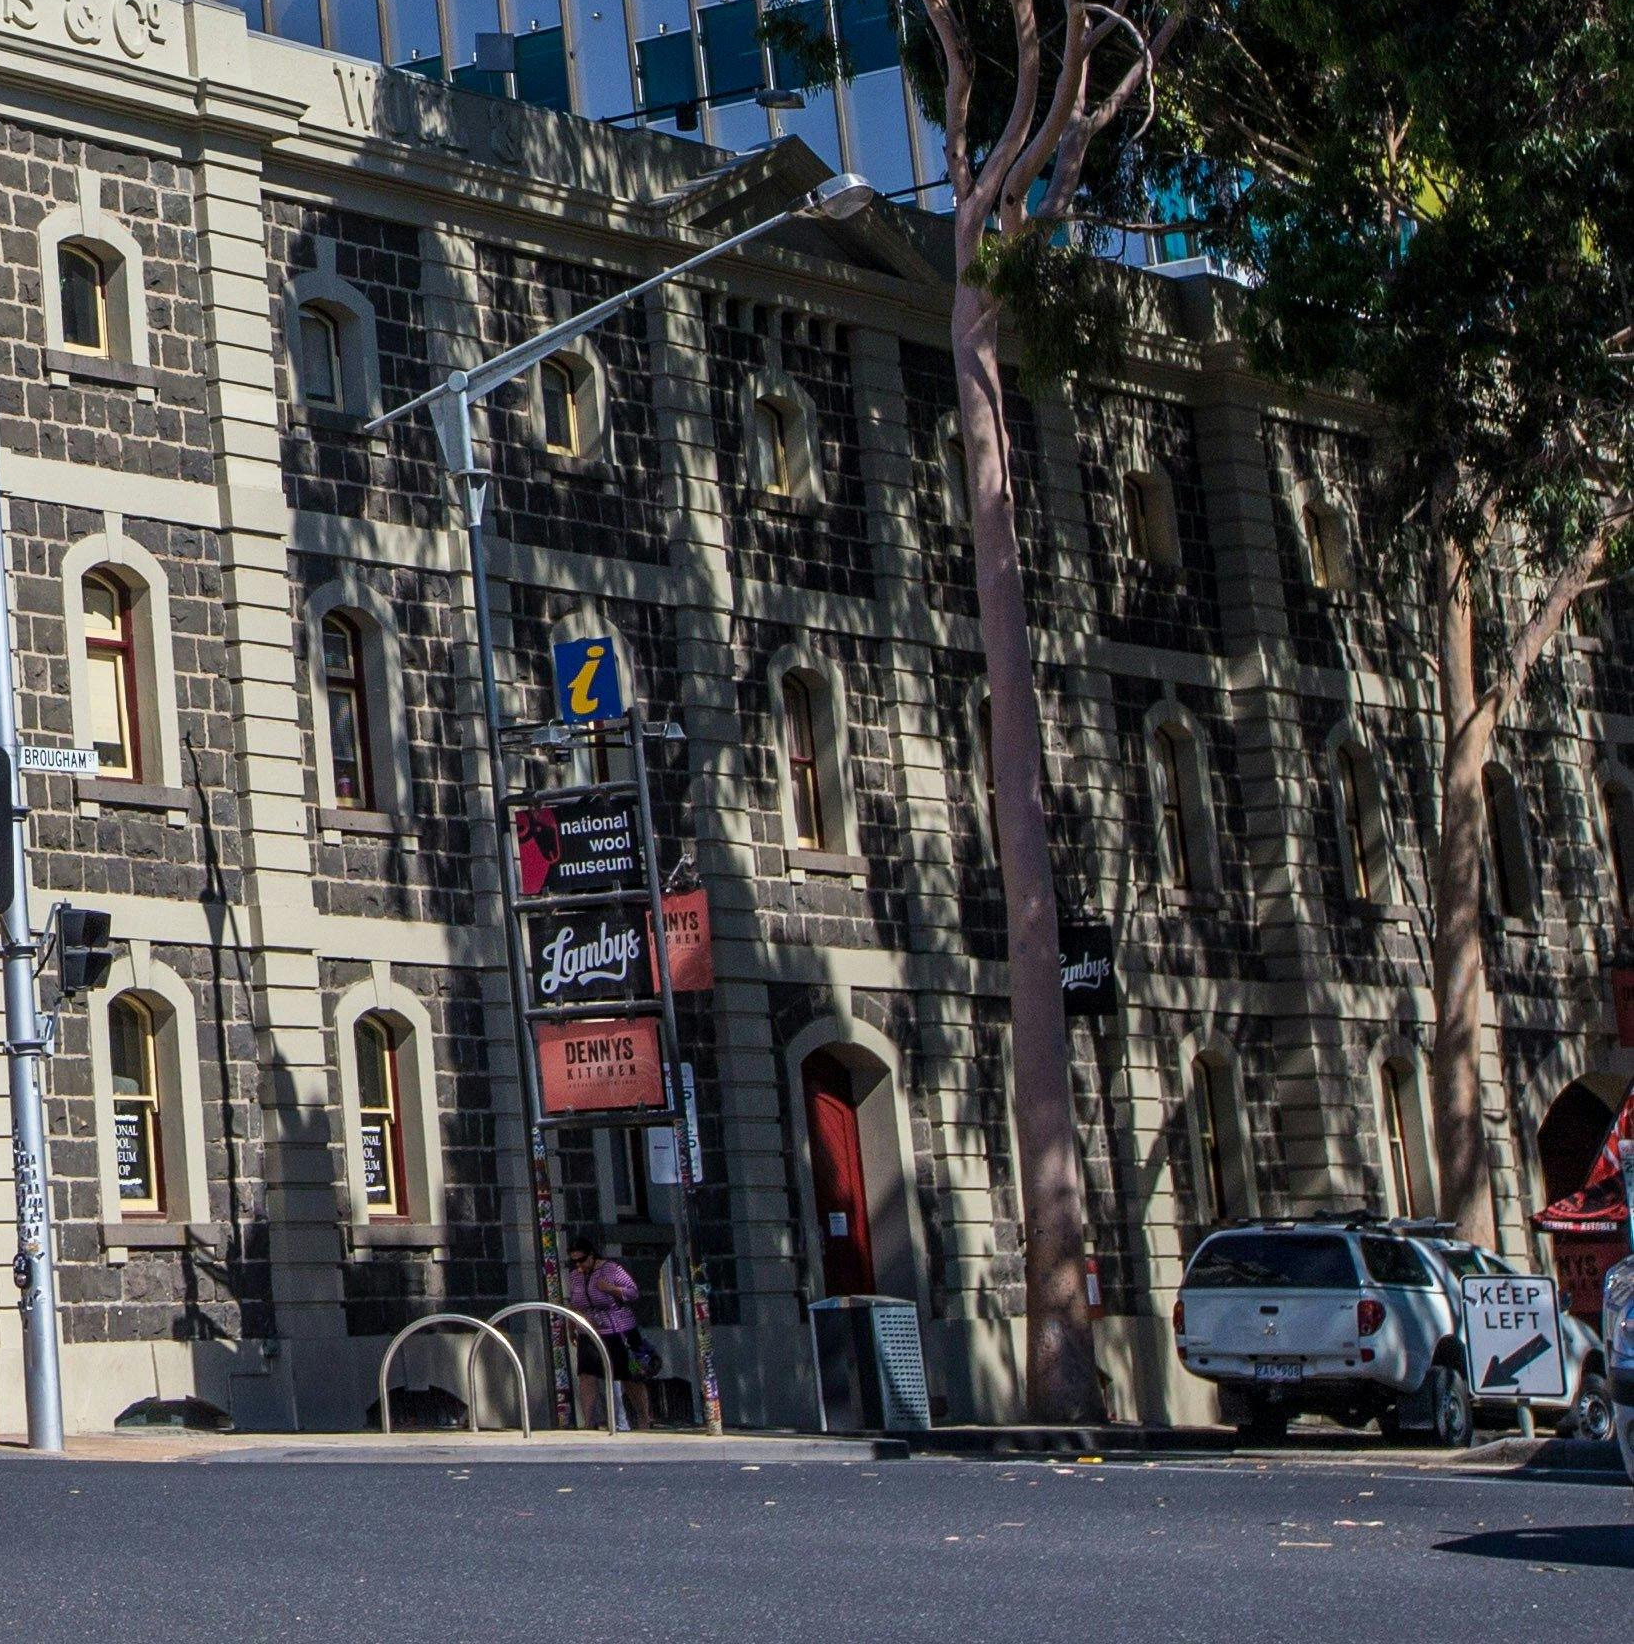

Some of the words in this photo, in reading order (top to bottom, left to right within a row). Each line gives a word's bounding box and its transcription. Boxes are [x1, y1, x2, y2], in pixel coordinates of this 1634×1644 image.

[24, 748, 87, 769] BROUGHAM
[560, 811, 629, 836] national
[589, 831, 631, 852] wool
[558, 856, 633, 877] museum
[540, 921, 641, 994] Lambys
[1059, 951, 1111, 991] ambys
[565, 1037, 634, 1064] DENNYS
[566, 1063, 636, 1081] KITCHEN
[114, 1124, 138, 1136] ONAL
[117, 1151, 138, 1163] EUM
[118, 1164, 131, 1176] OP
[1479, 1286, 1540, 1305] KEEP
[1484, 1312, 1540, 1330] LEFT
